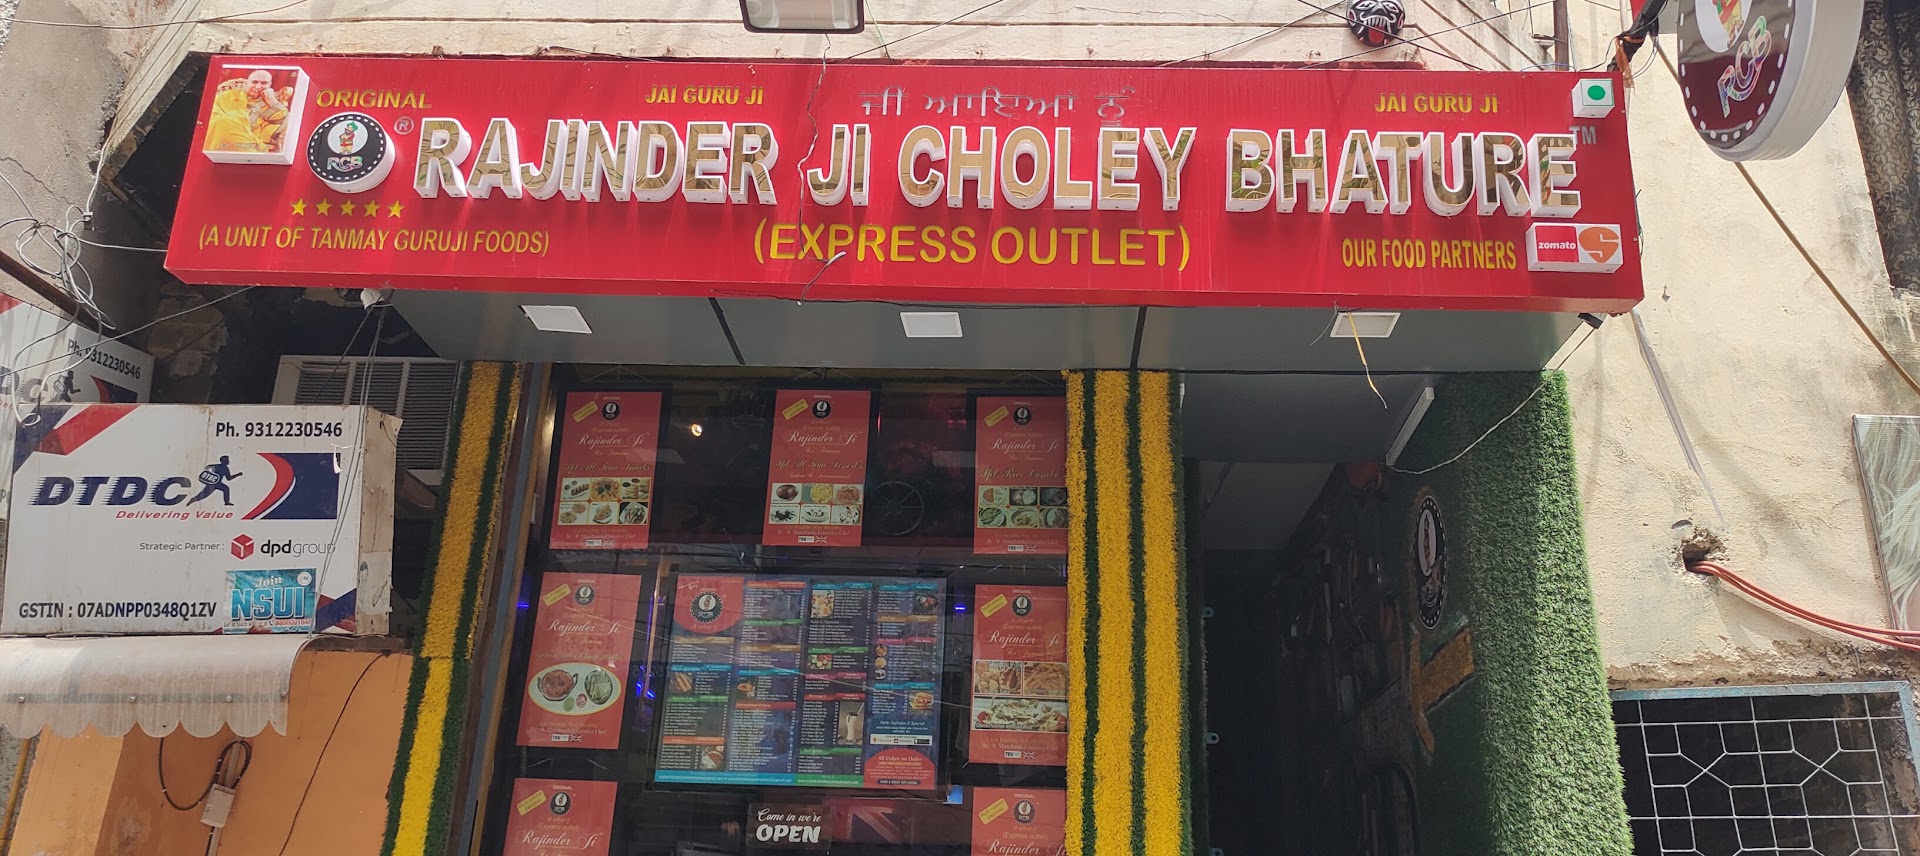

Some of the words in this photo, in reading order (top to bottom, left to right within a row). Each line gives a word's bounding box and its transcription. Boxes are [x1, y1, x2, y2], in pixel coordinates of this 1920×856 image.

[1717, 15, 1772, 118] RCB
[316, 89, 432, 109] ORIGINAL
[645, 85, 678, 104] JAI
[682, 86, 739, 105] GURU
[745, 86, 764, 105] JI
[1375, 92, 1407, 113] JAI
[1413, 93, 1472, 113] GURU
[1478, 93, 1499, 113] JI
[1569, 126, 1597, 145] TM
[327, 156, 363, 173] RCB
[413, 117, 779, 205] RAJINDER
[806, 123, 872, 207] JI
[897, 124, 1198, 211] CHOLEY
[1225, 127, 1582, 218] BHATURE
[199, 224, 219, 250] (A
[225, 226, 273, 248] UNIT
[275, 226, 304, 248] OF
[310, 227, 390, 250] TANMAY
[393, 229, 468, 252] GURUJI
[473, 230, 550, 256] FOODS)
[753, 217, 977, 265] (EXPRESS
[991, 224, 1190, 272] OUTLET)
[1537, 241, 1576, 251] zomato
[1342, 237, 1378, 268] OUR
[1381, 238, 1426, 269] FOOD
[1431, 239, 1517, 270] PARTNERS
[216, 422, 239, 437] Ph.
[245, 422, 343, 437] 9312230546
[785, 431, 834, 447] Rajinder
[577, 433, 622, 450] Rajinder
[992, 439, 1037, 454] Rajinder
[28, 476, 191, 506] DTDC
[116, 510, 190, 521] Delivering
[195, 510, 234, 520] Value
[139, 542, 183, 552] Strategic
[184, 542, 220, 551] Partner
[260, 539, 336, 559] dpdgroup
[255, 575, 283, 588] Join
[19, 602, 64, 618] GSTIN
[77, 601, 217, 621] 07ADNPP0348Q1ZV
[230, 586, 305, 620] NSUI
[548, 620, 597, 637] Rajinder
[989, 631, 1037, 648] Rajinder
[757, 808, 785, 823] Come
[786, 812, 796, 822] in
[797, 812, 822, 823] we're
[521, 830, 571, 849] Rajinder
[756, 824, 821, 844] OPEN
[986, 839, 1040, 856] Rajinder
